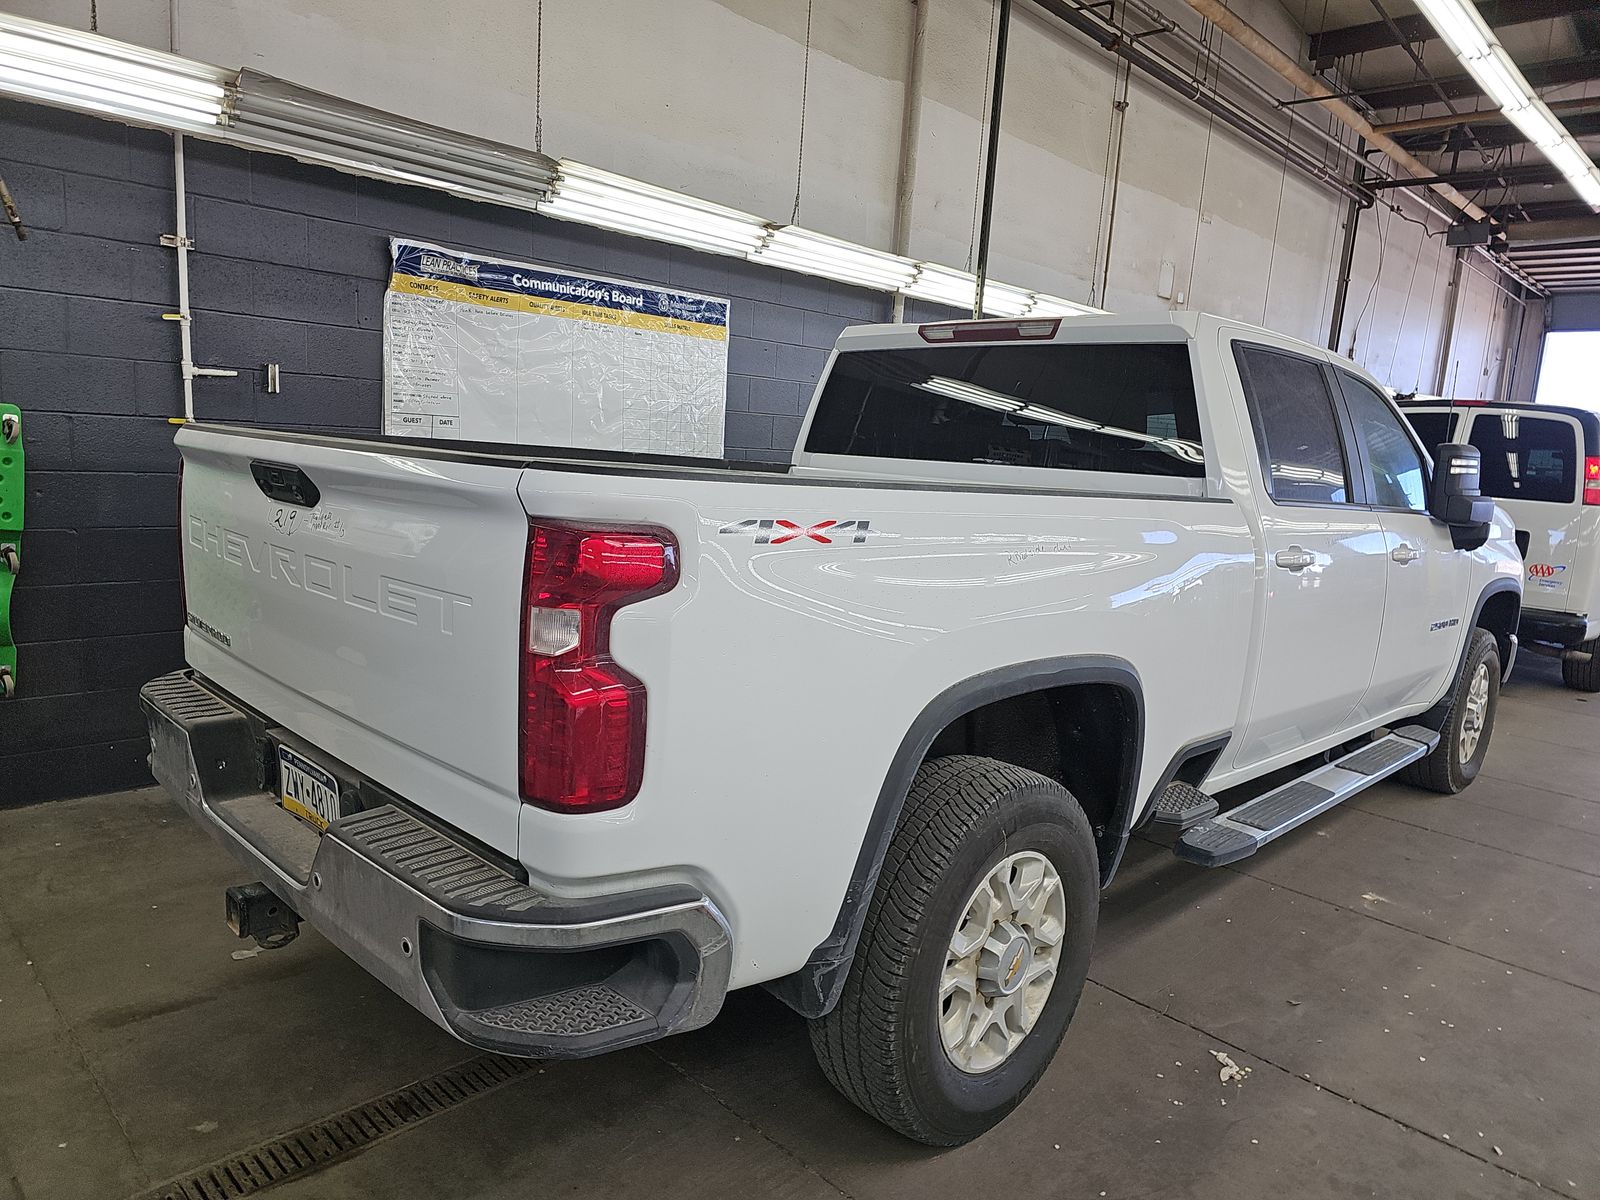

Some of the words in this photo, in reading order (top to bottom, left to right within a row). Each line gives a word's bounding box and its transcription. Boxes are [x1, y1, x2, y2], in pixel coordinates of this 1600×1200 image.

[421, 255, 441, 268] LEAN
[442, 260, 478, 276] PRACTICES
[409, 281, 439, 293] CONTACTS
[512, 273, 609, 300] Communication's
[611, 290, 644, 306] Board
[468, 292, 490, 301] SAFETY
[490, 294, 509, 304] ALERTS
[403, 416, 422, 424] GUEST
[439, 418, 453, 426] DATE
[189, 515, 472, 635] CHEVROLET
[1529, 564, 1554, 577] AAA
